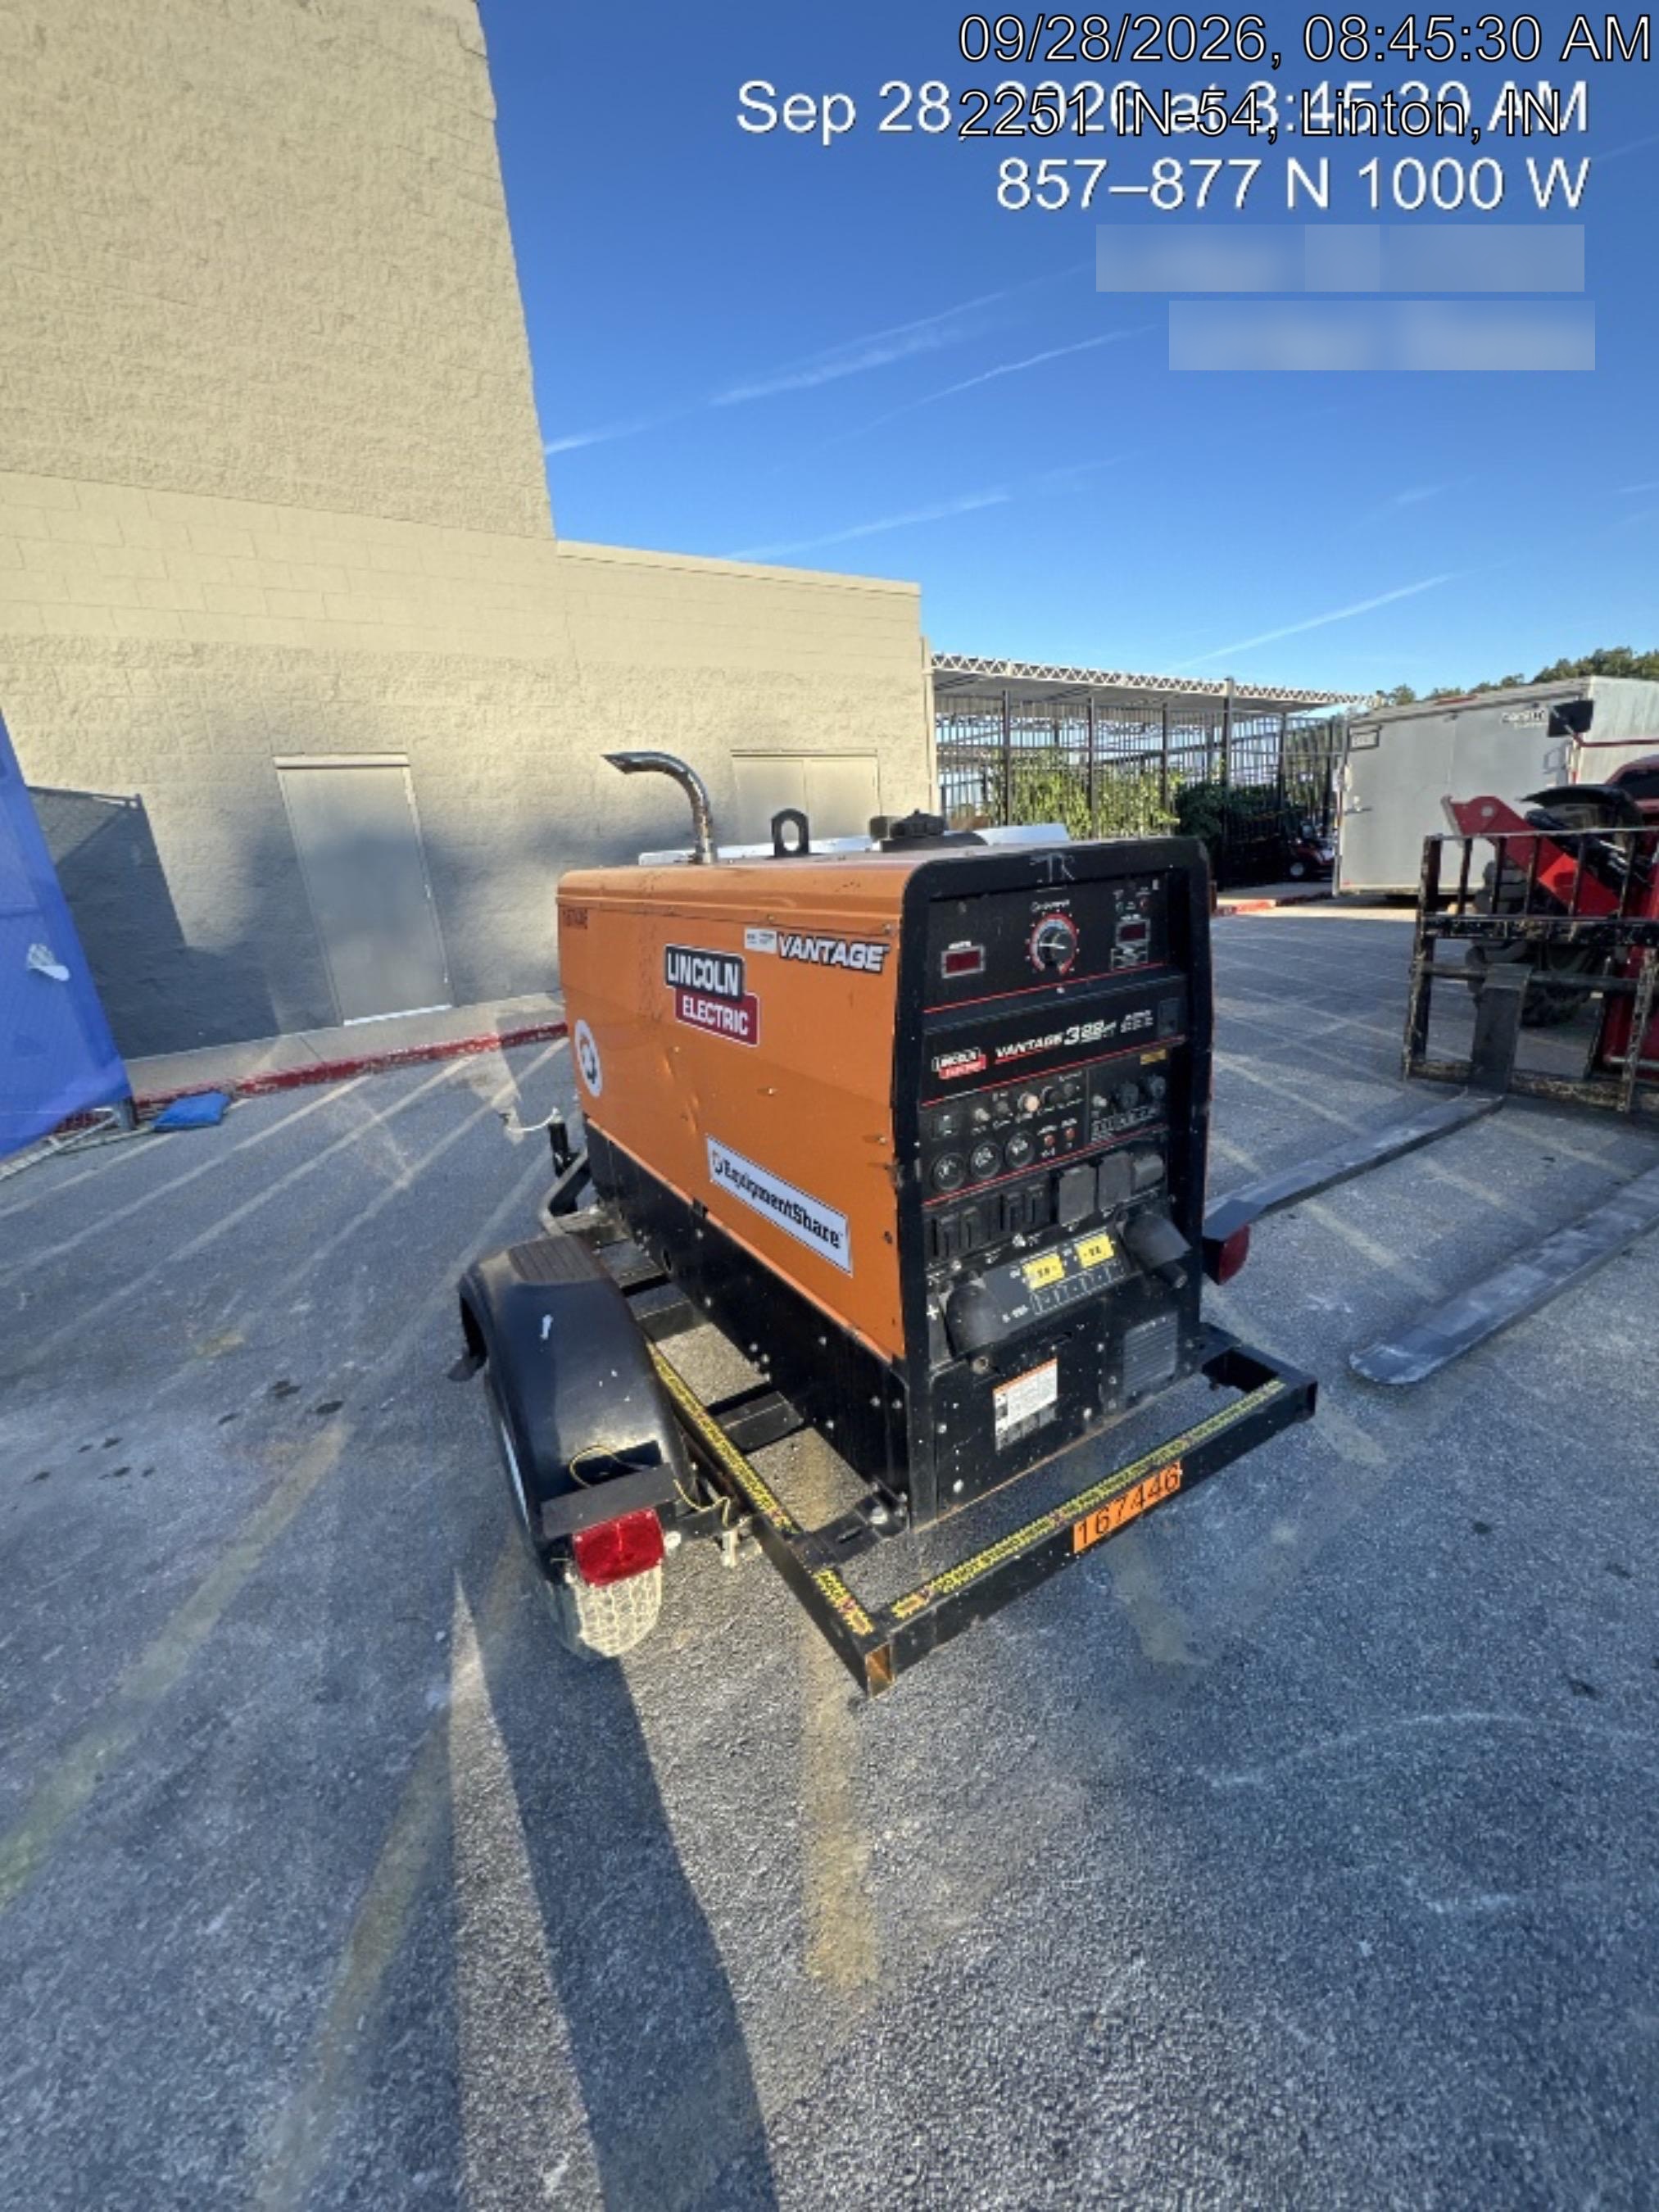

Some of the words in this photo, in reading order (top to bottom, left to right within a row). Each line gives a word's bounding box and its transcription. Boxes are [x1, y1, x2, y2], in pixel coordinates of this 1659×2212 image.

[668, 952, 739, 997] LINCOLN
[778, 932, 886, 972] VANTAGE
[682, 994, 749, 1036] ELECTRIC
[723, 1157, 841, 1250] EquipmentShare
[1078, 1463, 1179, 1545] 167446
